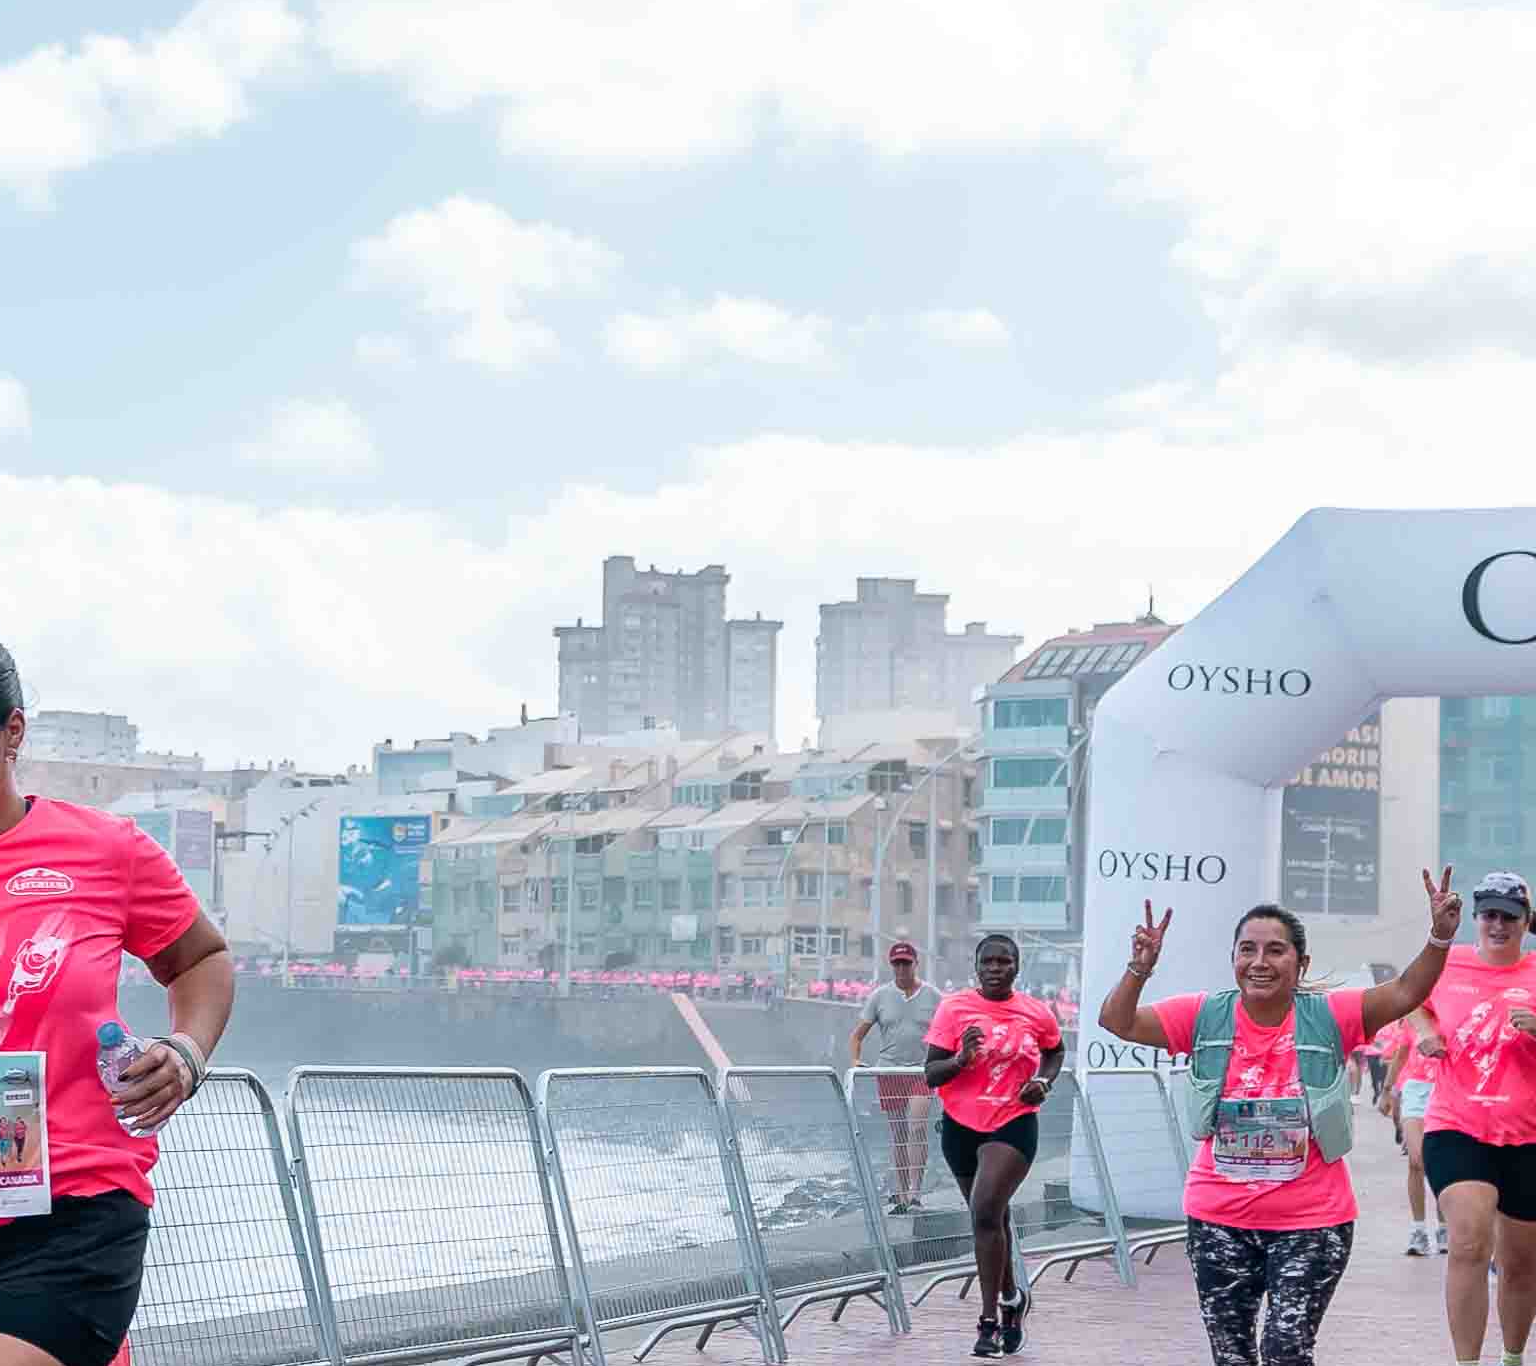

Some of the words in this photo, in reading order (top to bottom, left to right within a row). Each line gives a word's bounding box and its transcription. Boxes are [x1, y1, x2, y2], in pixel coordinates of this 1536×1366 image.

[1166, 663, 1312, 698] OYSHO
[1098, 849, 1227, 884] OYSHO
[1087, 1041, 1193, 1068] OYSH
[1241, 1134, 1275, 1148] 112
